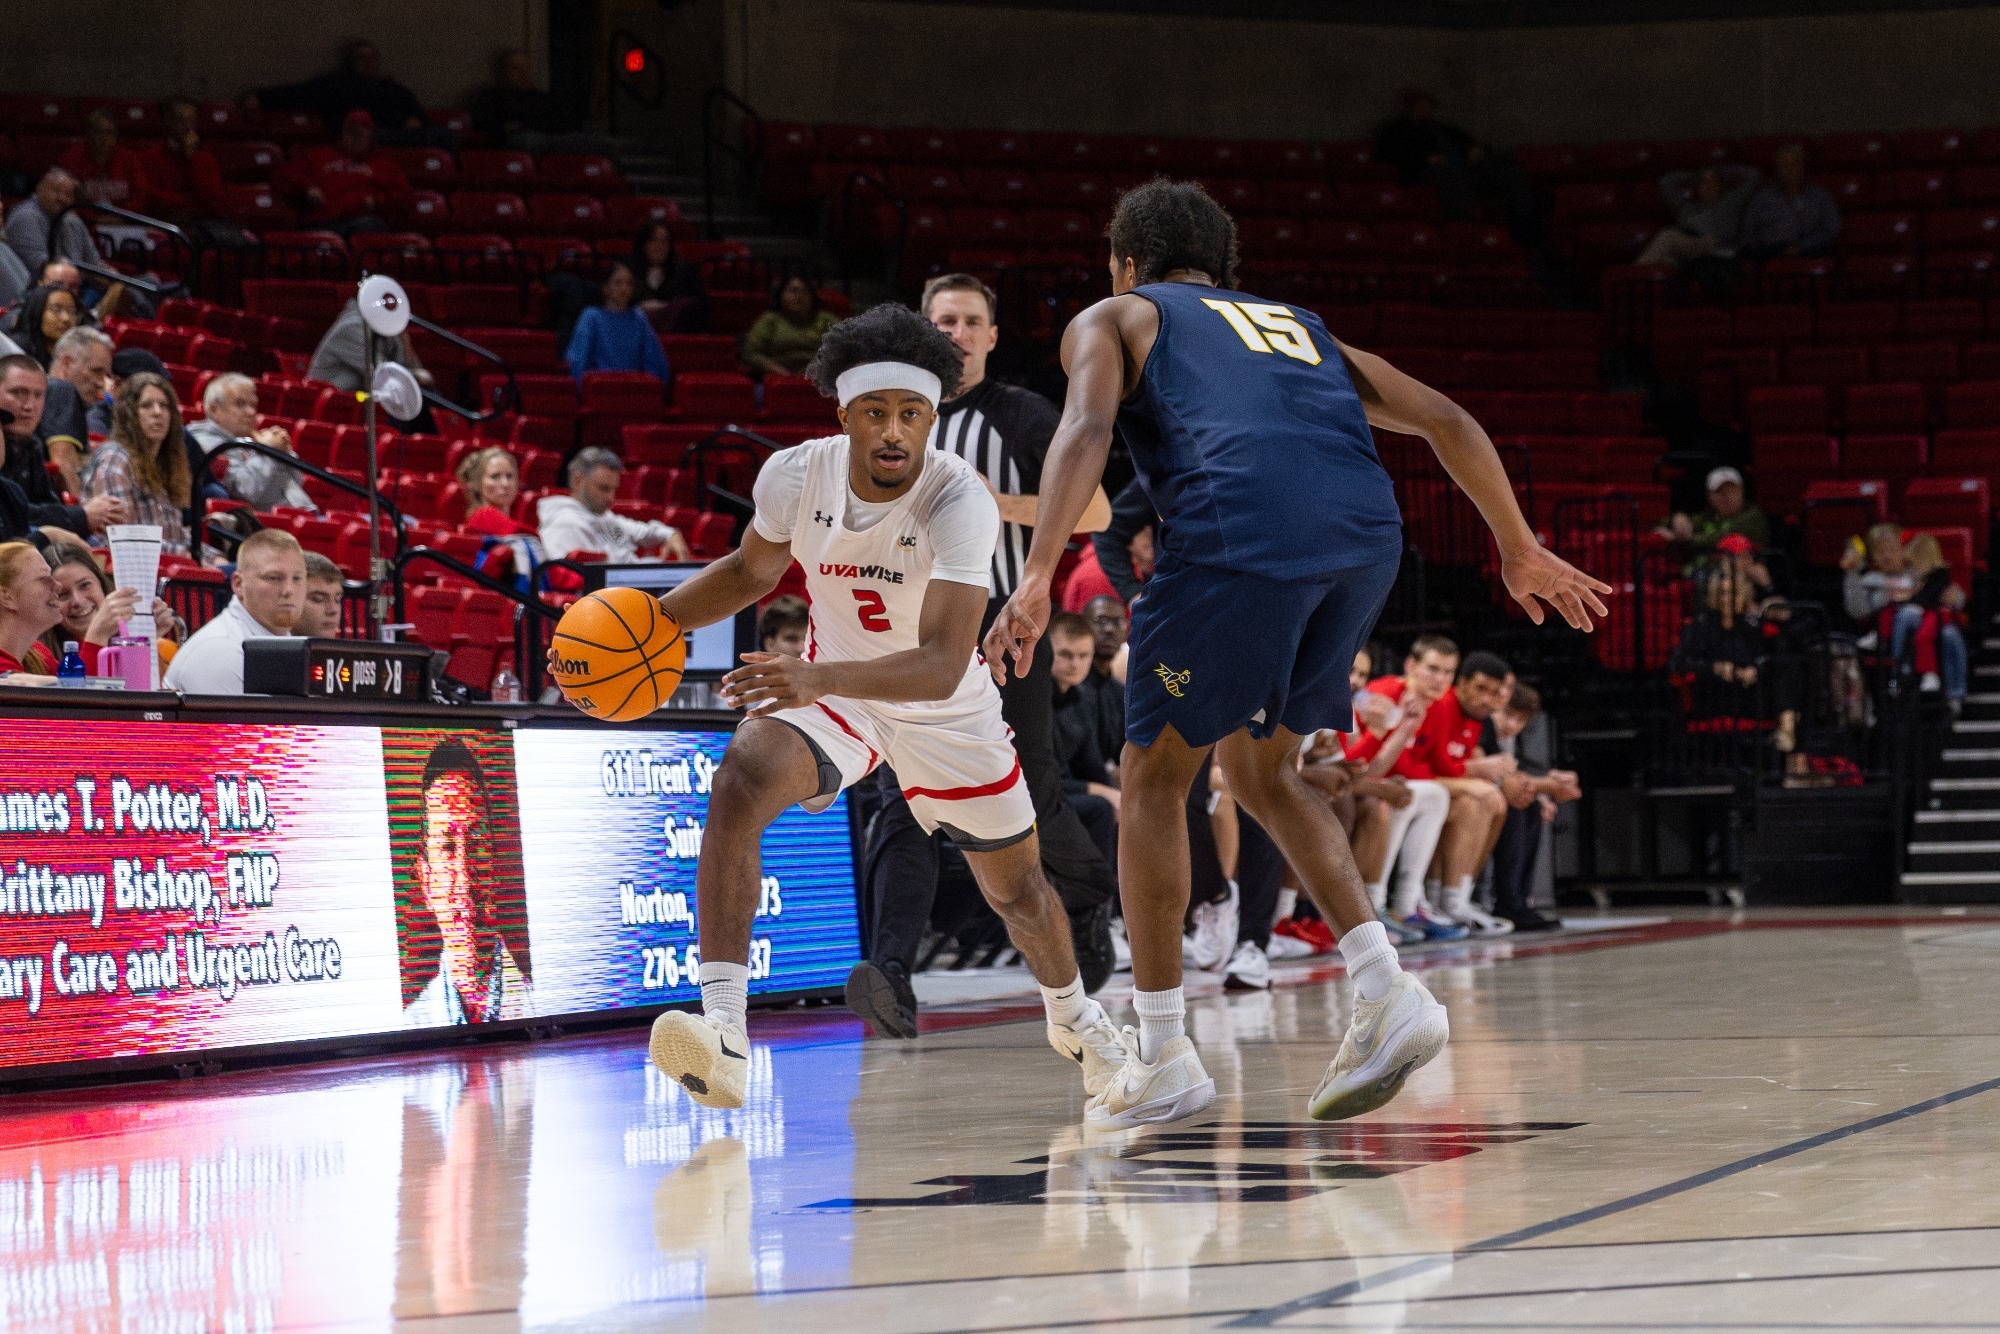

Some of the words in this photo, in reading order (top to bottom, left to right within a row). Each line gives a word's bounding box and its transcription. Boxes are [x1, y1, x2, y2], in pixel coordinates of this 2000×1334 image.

[1200, 298, 1322, 366] 15
[852, 589, 892, 632] 2
[602, 749, 634, 797] 611
[639, 749, 693, 795] Trent
[76, 776, 105, 832] T.
[111, 776, 212, 847] Potter,
[216, 775, 276, 832] M.D.
[664, 813, 704, 859] Suit
[112, 856, 221, 924] Bishop,
[226, 853, 279, 906] FNP
[619, 881, 695, 934] Norton,
[52, 939, 118, 995] Care
[125, 932, 179, 992] and
[185, 931, 280, 1001] Urgent
[285, 926, 341, 982] Care
